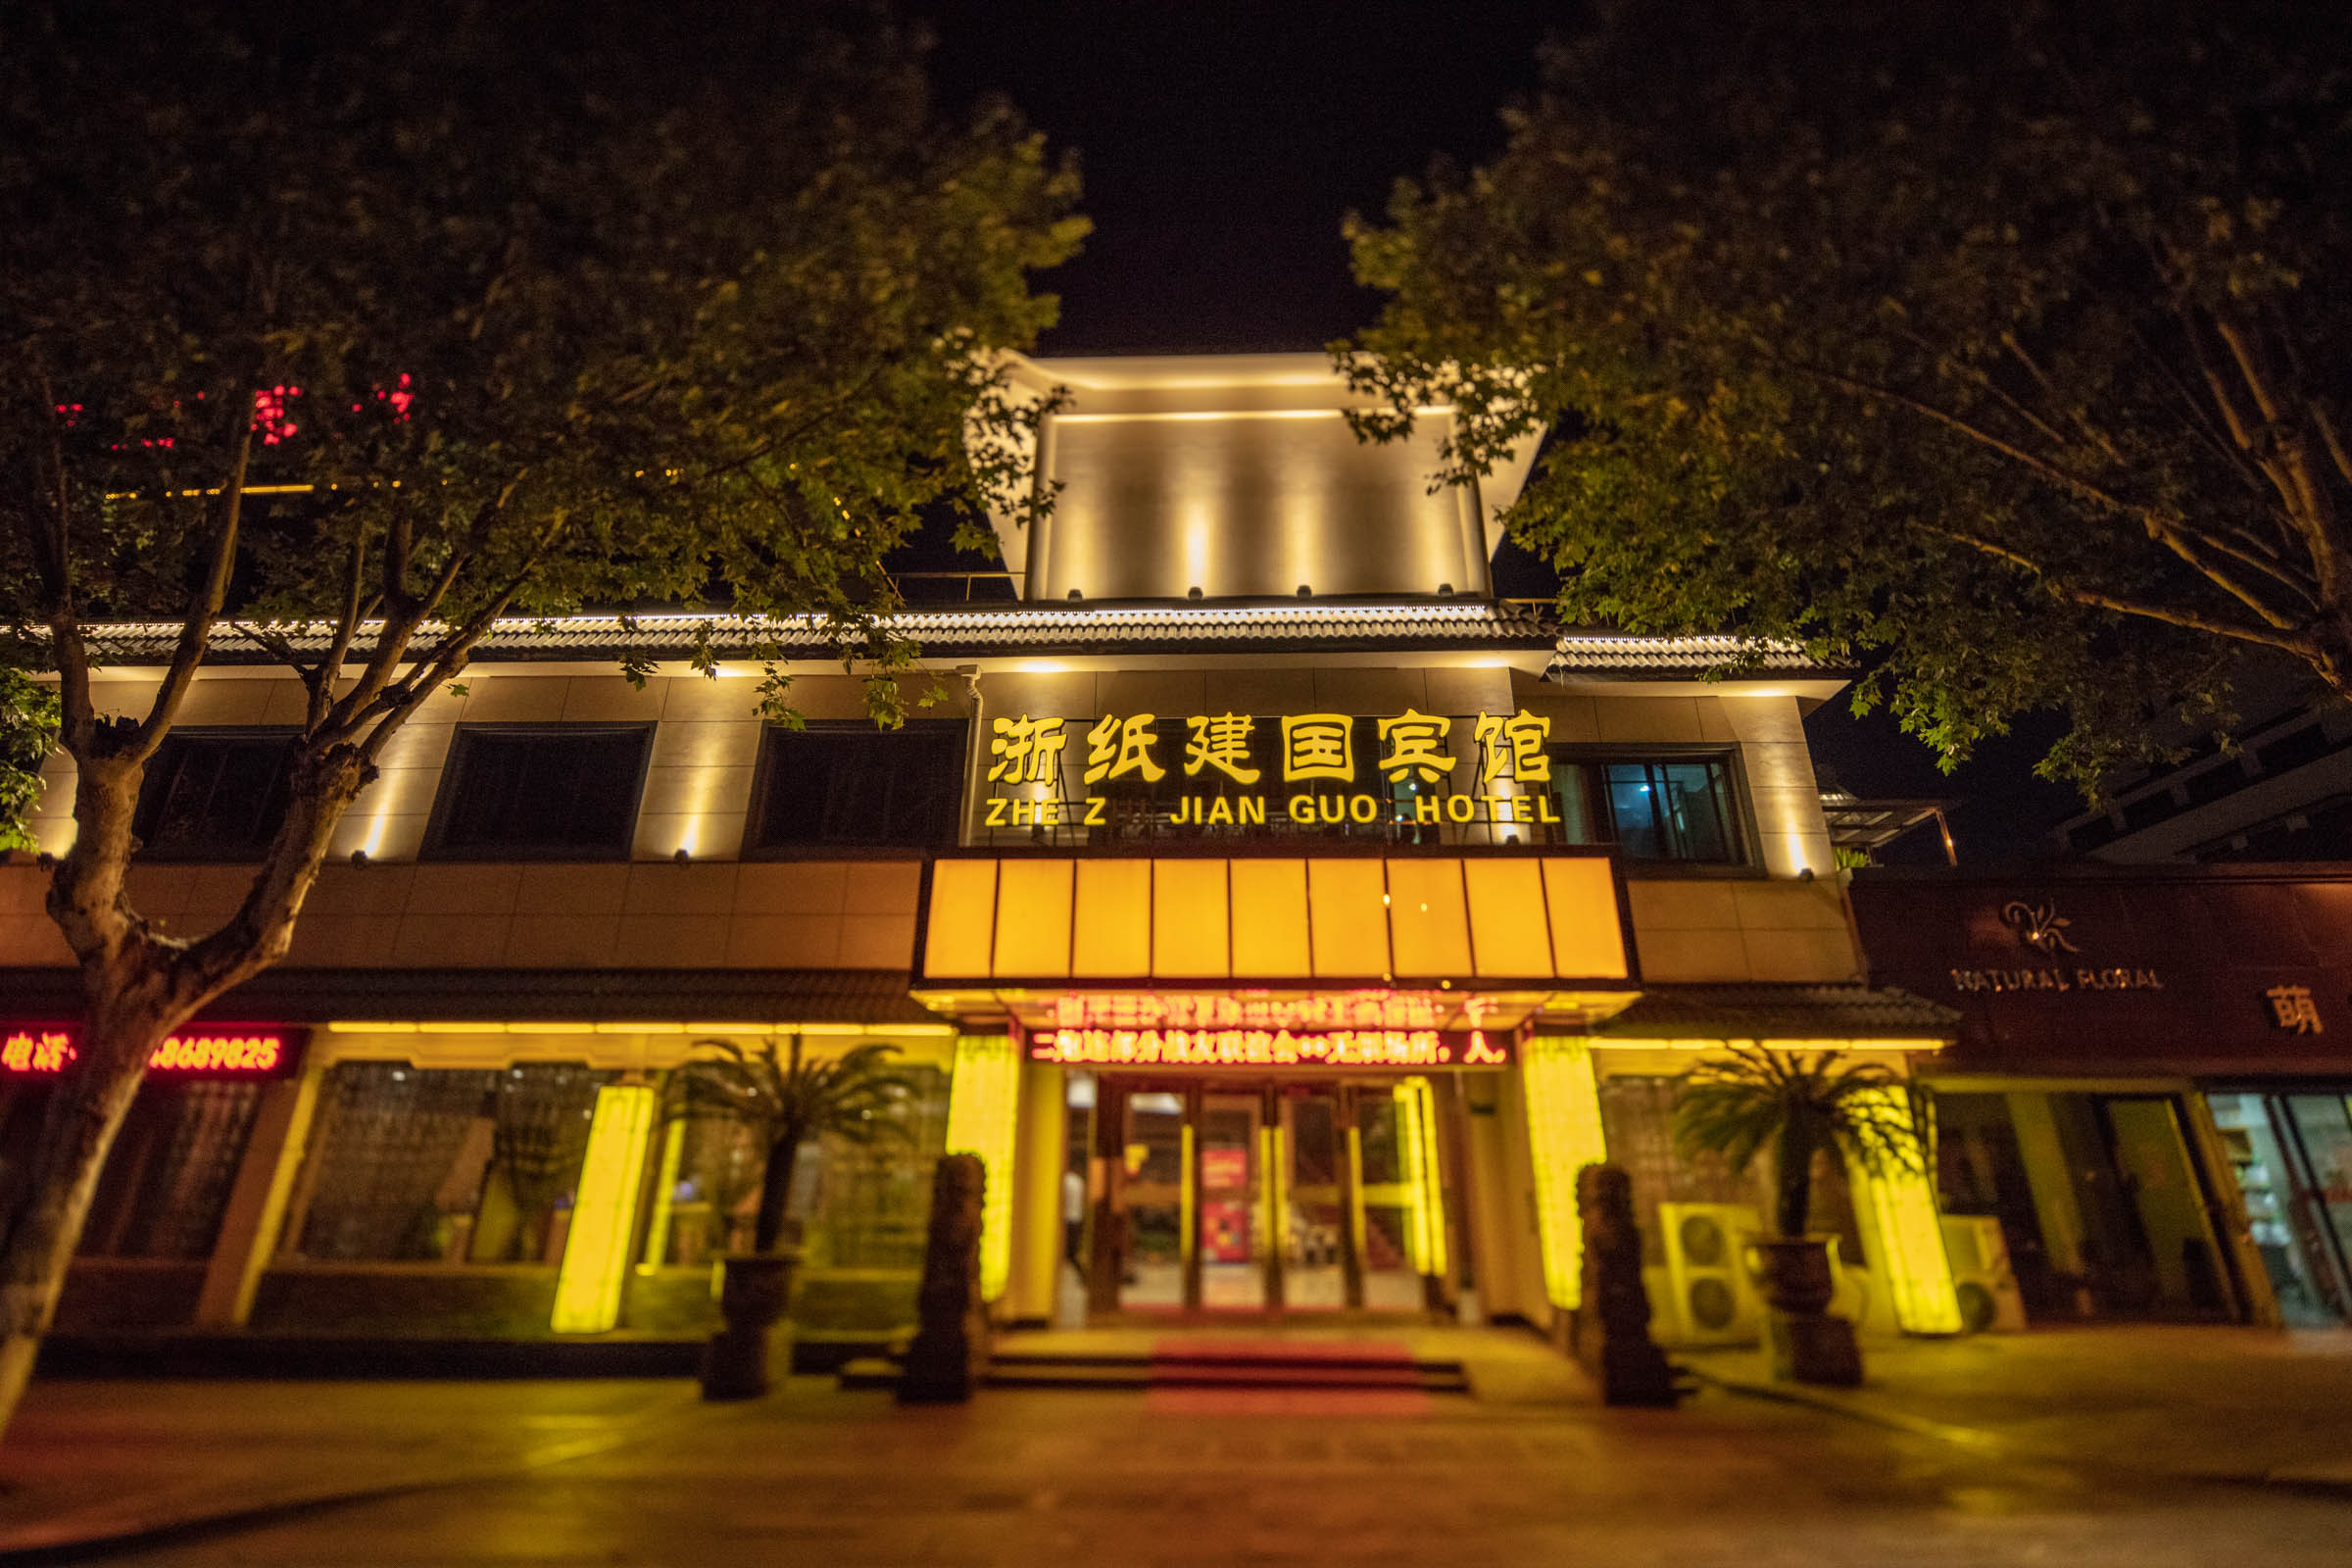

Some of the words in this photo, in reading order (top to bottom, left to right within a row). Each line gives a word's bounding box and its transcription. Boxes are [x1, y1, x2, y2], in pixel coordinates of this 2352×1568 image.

[987, 709, 1551, 786] 浙纸建国宾馆
[985, 797, 1059, 826] ZHE
[1170, 796, 1265, 825] JIAN
[1289, 794, 1378, 824] GUO
[1415, 794, 1560, 823] HOTEL
[2078, 968, 2164, 990] FLORAL
[2267, 985, 2322, 1034] 萌
[149, 1037, 280, 1070] 8689825
